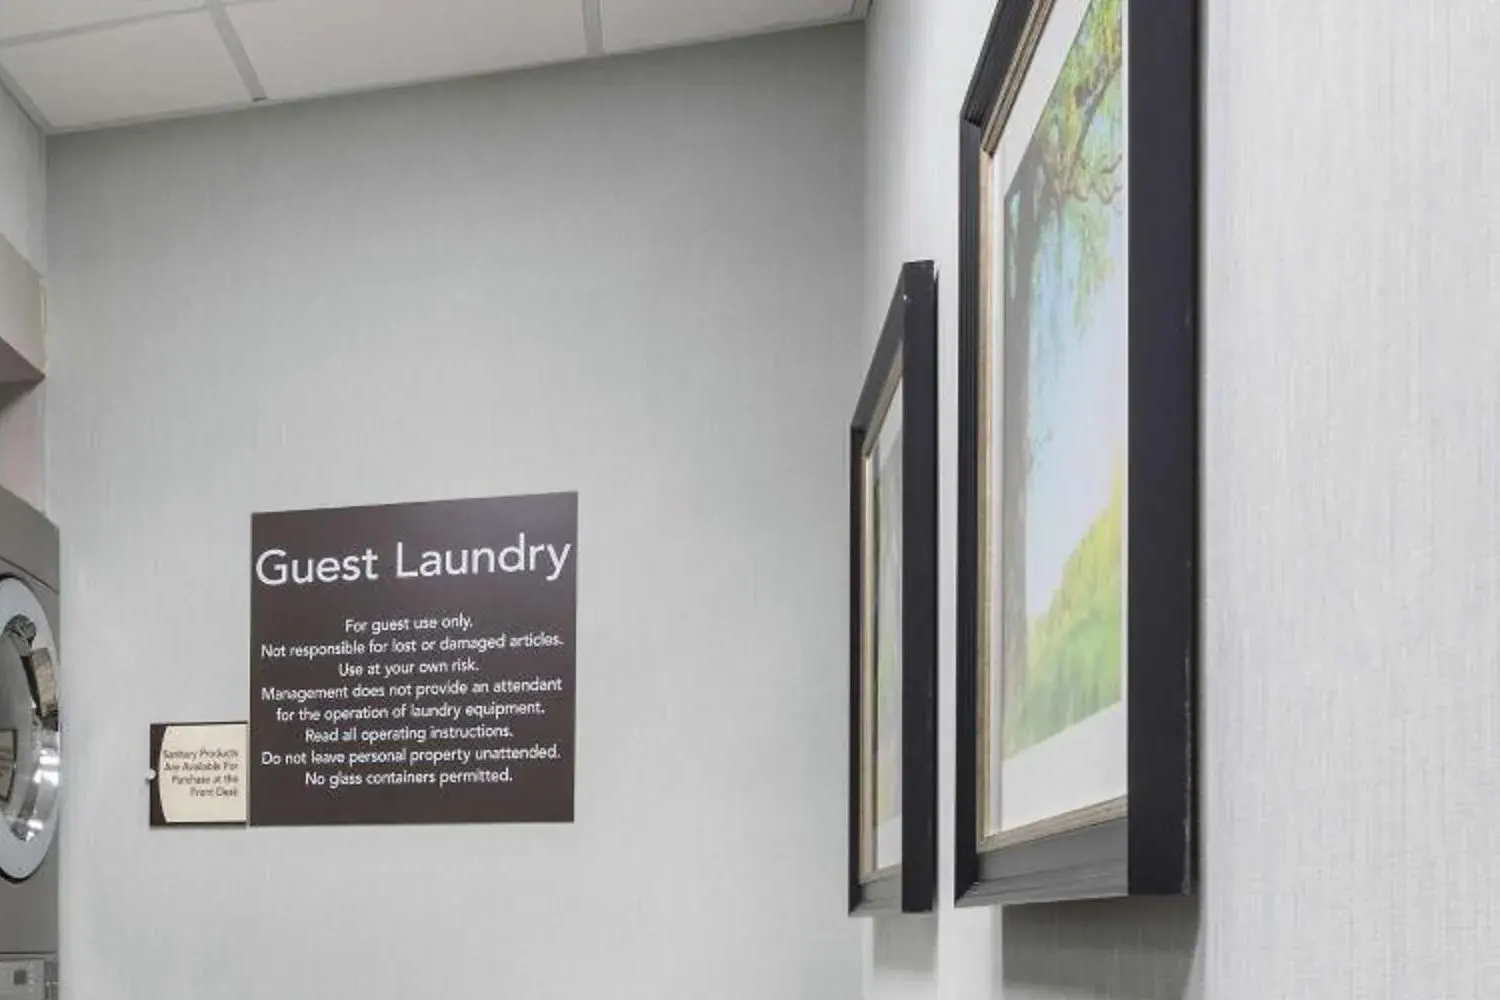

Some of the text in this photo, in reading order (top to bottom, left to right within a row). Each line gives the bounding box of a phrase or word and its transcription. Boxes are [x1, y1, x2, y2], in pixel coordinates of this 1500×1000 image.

[256, 532, 572, 587] Guest Laundry
[344, 612, 474, 635] For guest use only.
[261, 631, 565, 660] Not responsible for lost or damaged articles.
[338, 656, 480, 679] Use at your own risk.
[260, 675, 563, 703] Management does not provide an attendant
[276, 700, 546, 725] for the operation of laundry equipment.
[304, 722, 514, 745] Read all operating instructions.
[260, 742, 561, 768] Do not leave personal property unattended.
[304, 766, 514, 789] No glass containers permitted.
